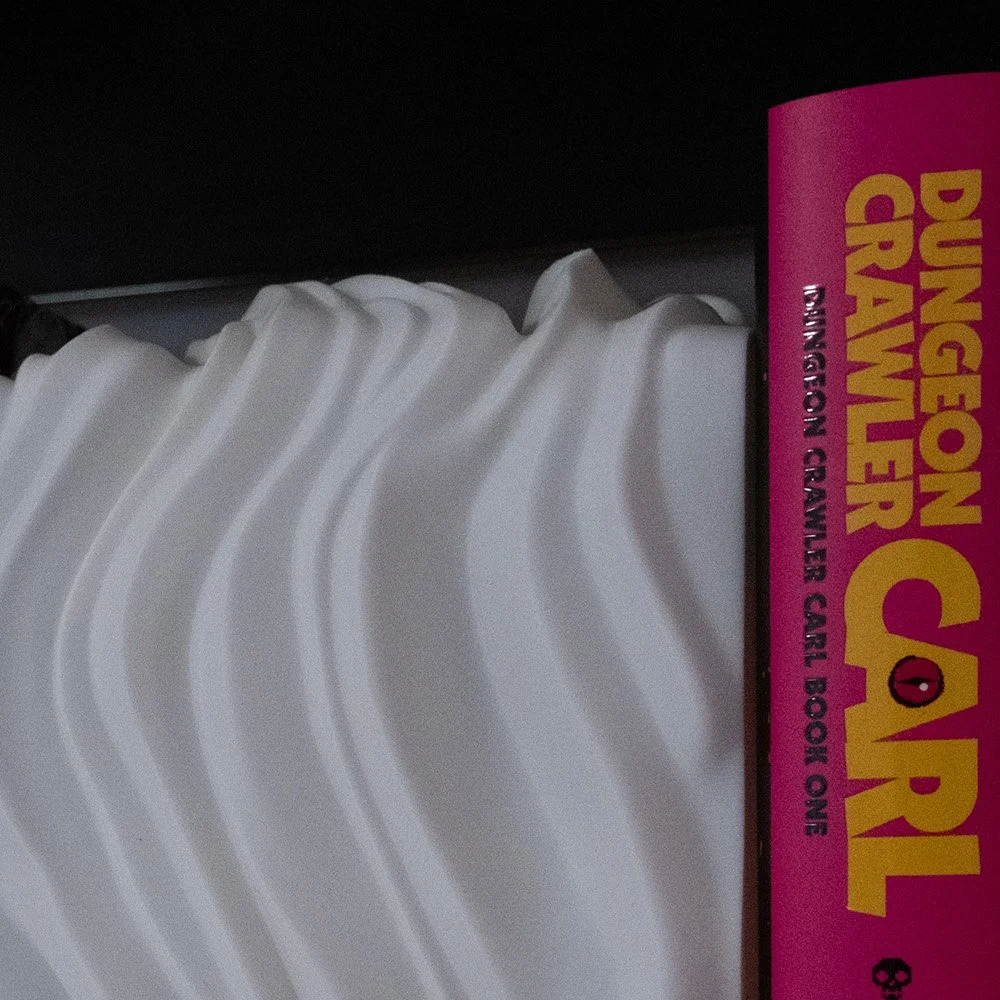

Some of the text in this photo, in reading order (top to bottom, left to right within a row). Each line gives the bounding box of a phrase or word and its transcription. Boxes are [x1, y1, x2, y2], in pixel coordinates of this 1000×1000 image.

[845, 173, 915, 535] CRAWLER
[919, 169, 982, 527] DUNGEON
[802, 284, 828, 836] DUNGEON CRAWLER CARL BOOK ONE
[844, 538, 982, 917] CARL
